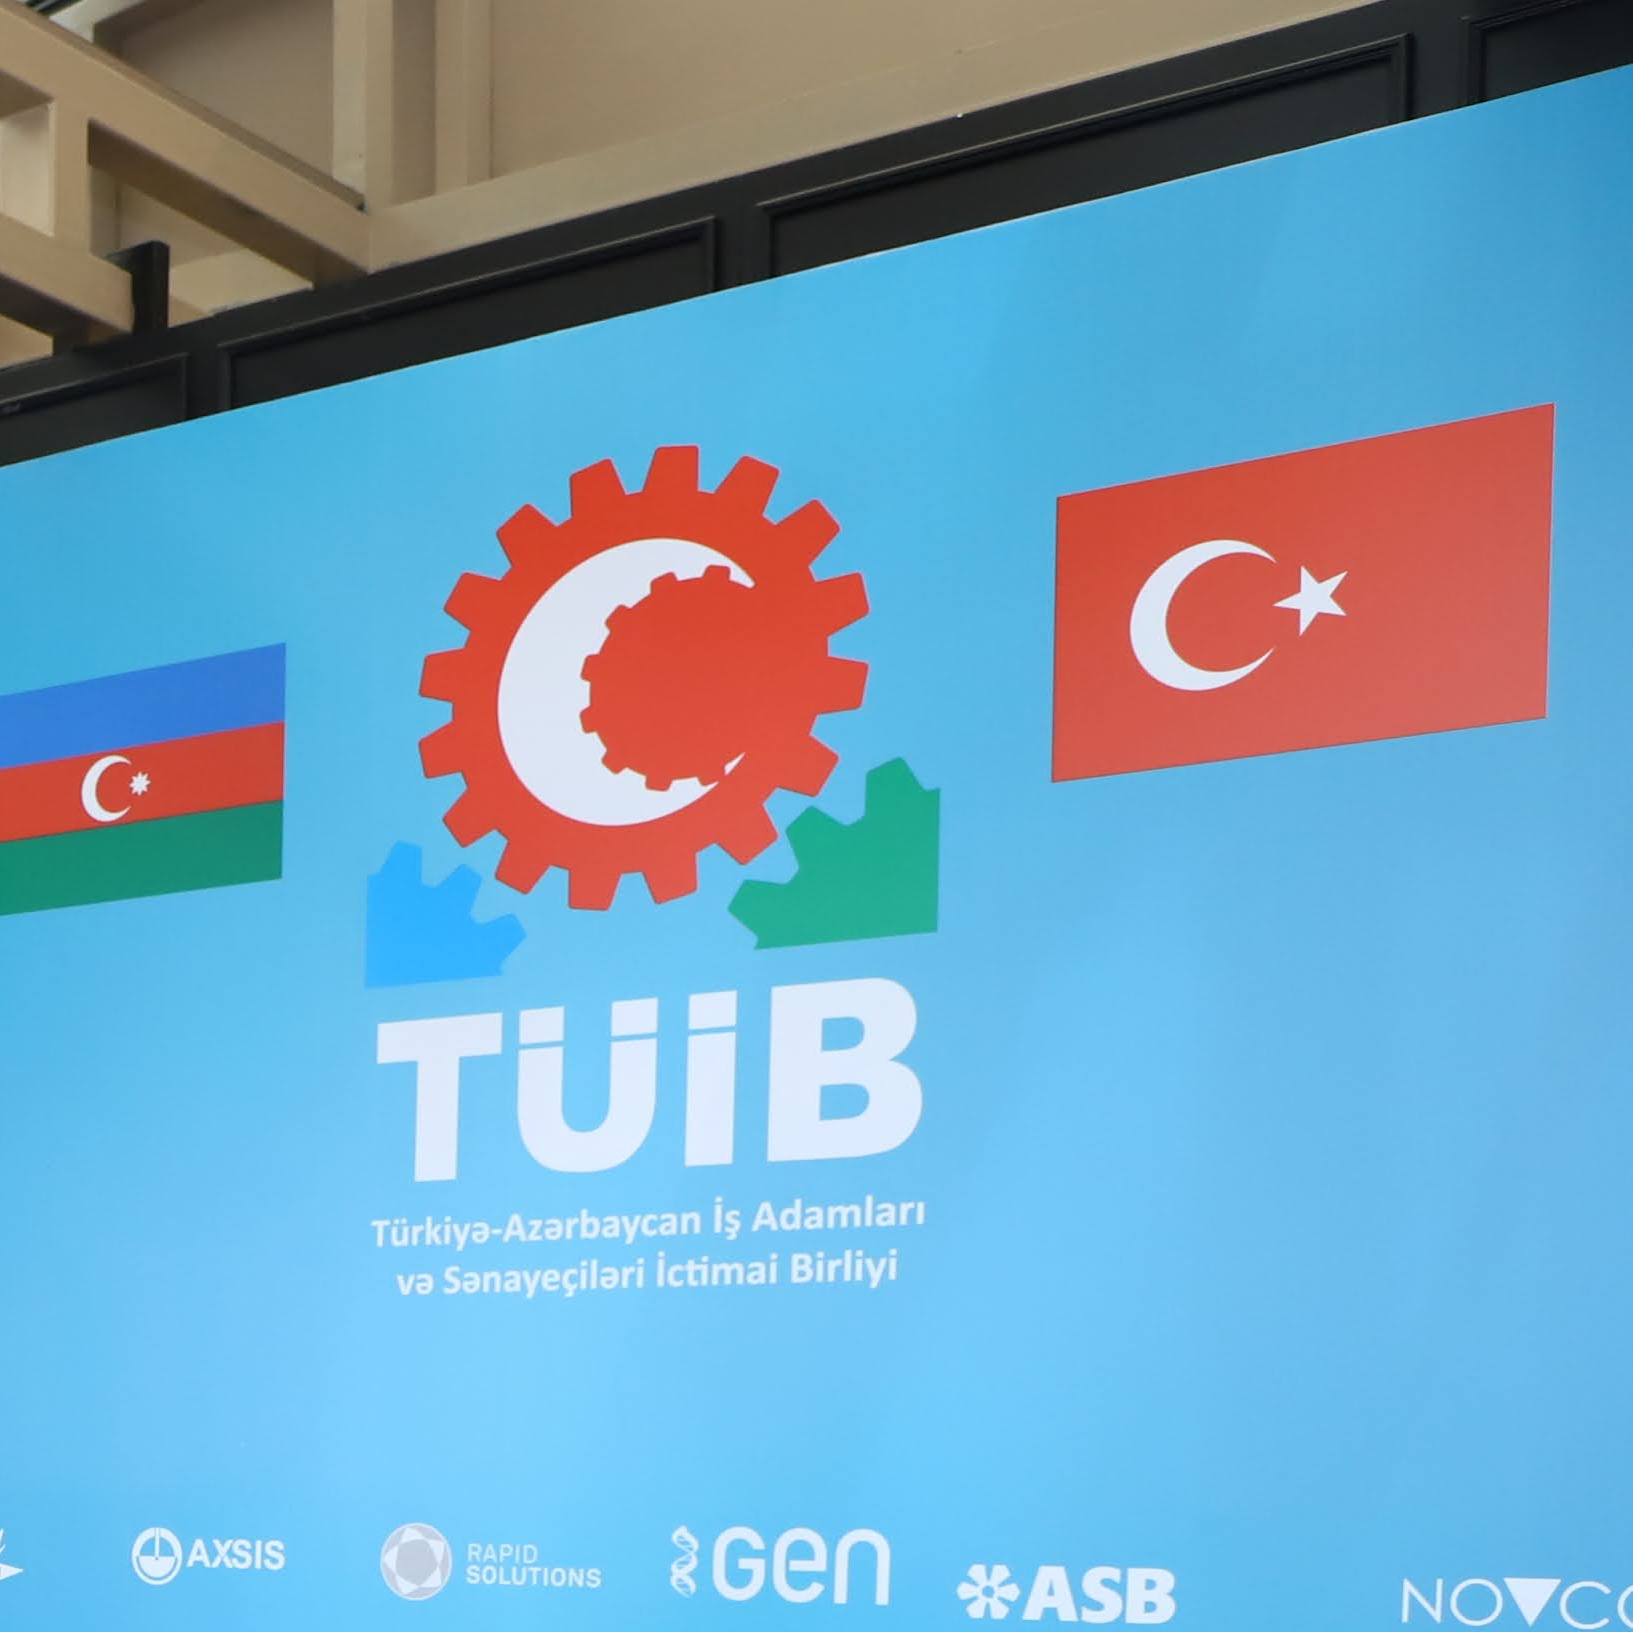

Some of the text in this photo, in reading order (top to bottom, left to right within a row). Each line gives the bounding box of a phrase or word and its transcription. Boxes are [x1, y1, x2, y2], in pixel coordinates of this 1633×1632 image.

[371, 1194, 926, 1254] Türkiyə-Azərbaycan İş Adamları
[396, 1249, 898, 1299] və Sənayeçiləri İctimai Birliyi
[186, 1539, 286, 1571] AXSIS
[467, 1544, 537, 1564] RAPID
[466, 1565, 601, 1588] SOLUTIONS
[1022, 1565, 1176, 1625] ASB
